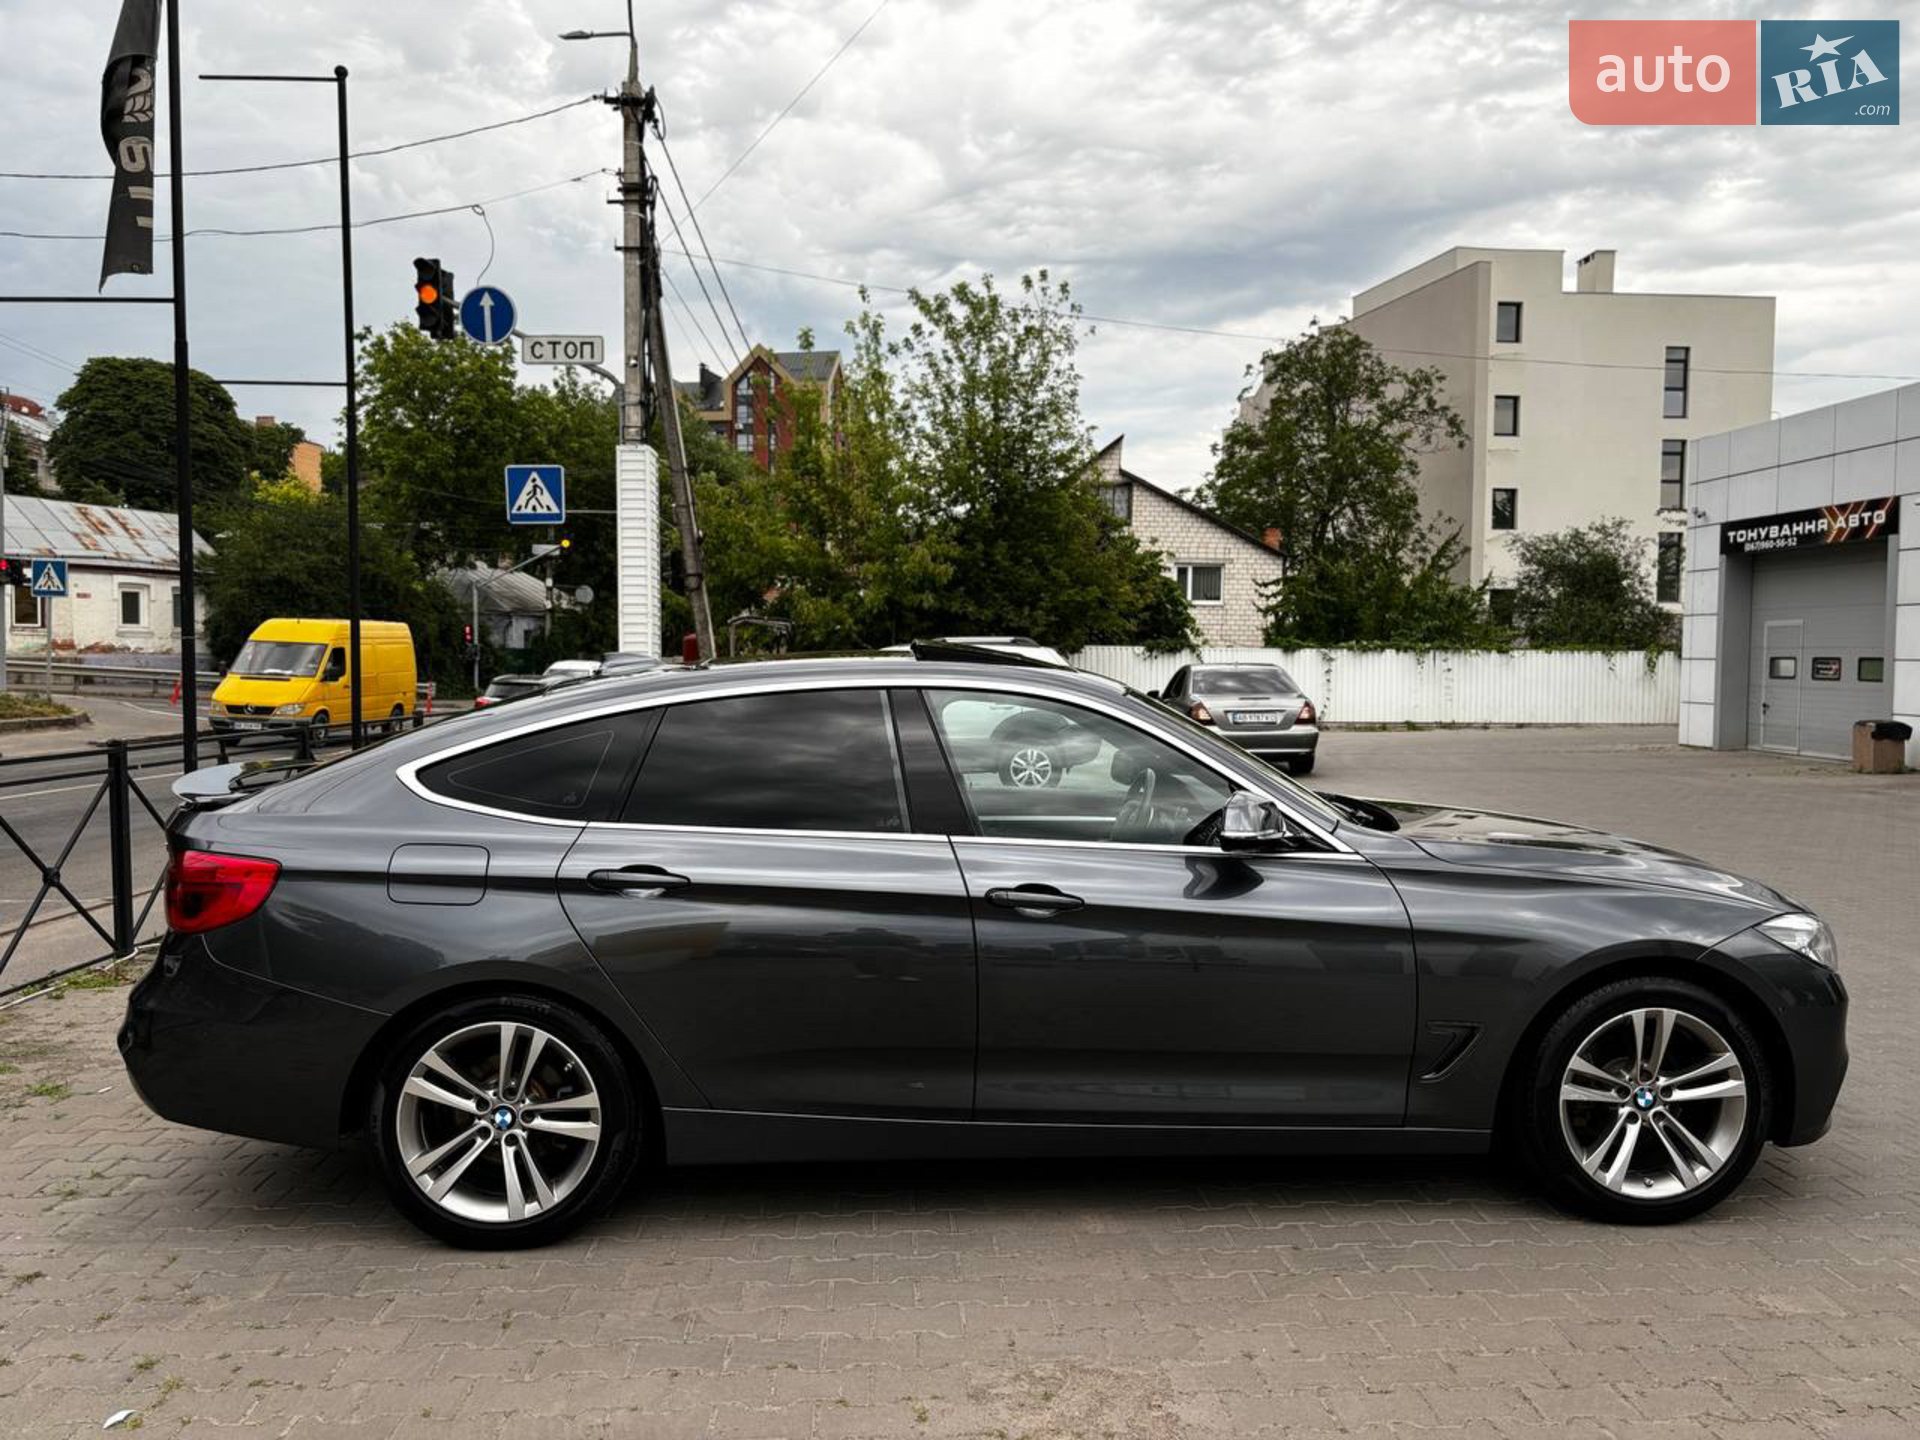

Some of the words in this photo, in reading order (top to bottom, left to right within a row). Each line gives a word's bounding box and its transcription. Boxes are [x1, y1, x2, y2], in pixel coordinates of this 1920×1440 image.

[530, 341, 595, 360] СТОП
[1727, 518, 1828, 543] ТОНУВАННЯ
[1835, 510, 1886, 529] АВТО
